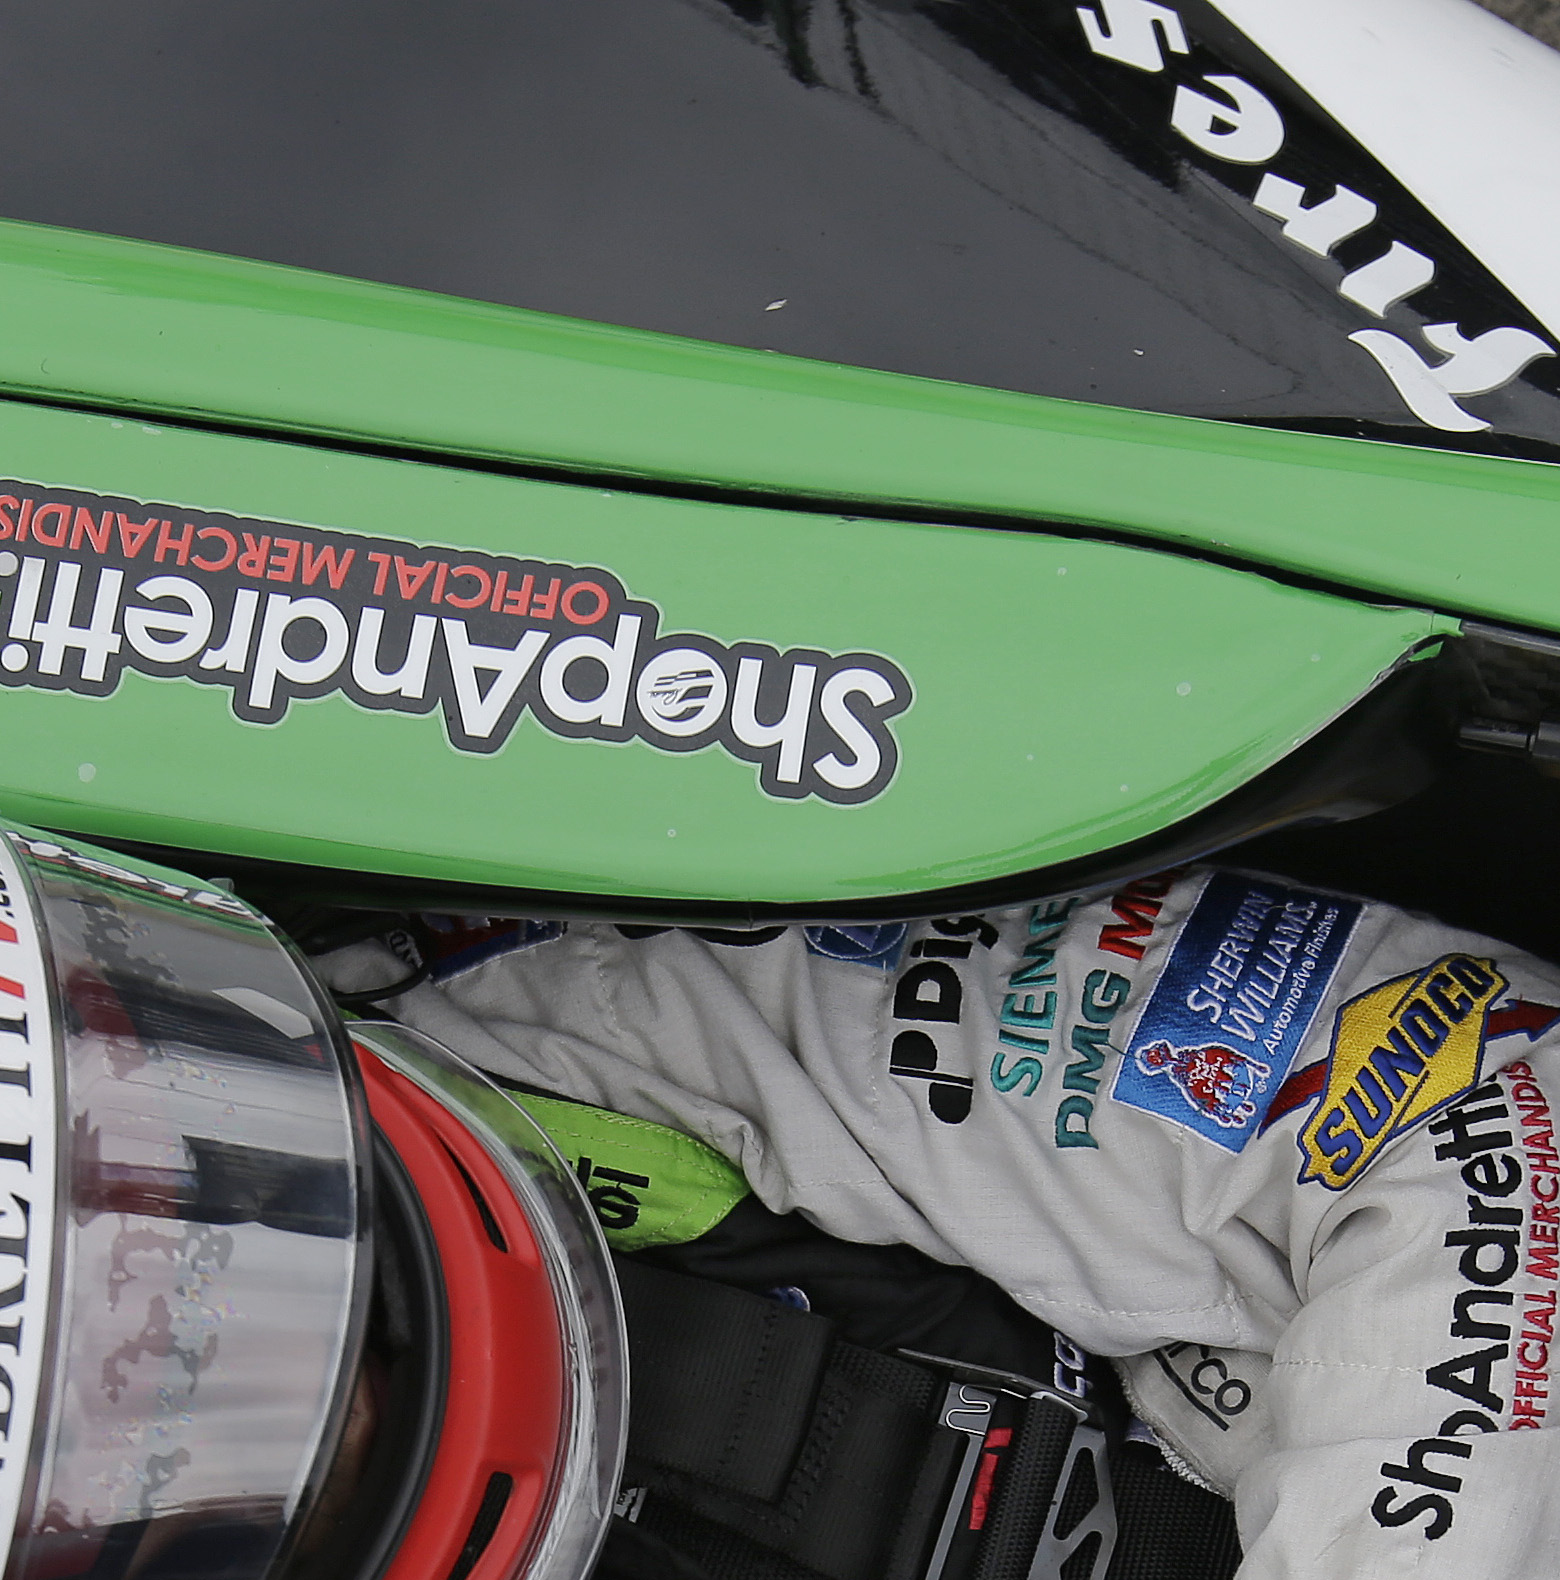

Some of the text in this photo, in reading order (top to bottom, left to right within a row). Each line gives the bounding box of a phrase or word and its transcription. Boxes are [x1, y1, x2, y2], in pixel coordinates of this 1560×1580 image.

[368, 549, 610, 626] OFFICIAL
[990, 895, 1080, 1099] SIEME
[1186, 889, 1275, 1022] SHERWIN
[1265, 957, 1316, 1055] Automotive
[1056, 970, 1132, 1150] DMG
[1320, 958, 1500, 1178] SUNOCO
[1508, 1290, 1558, 1433] OFFICIAL
